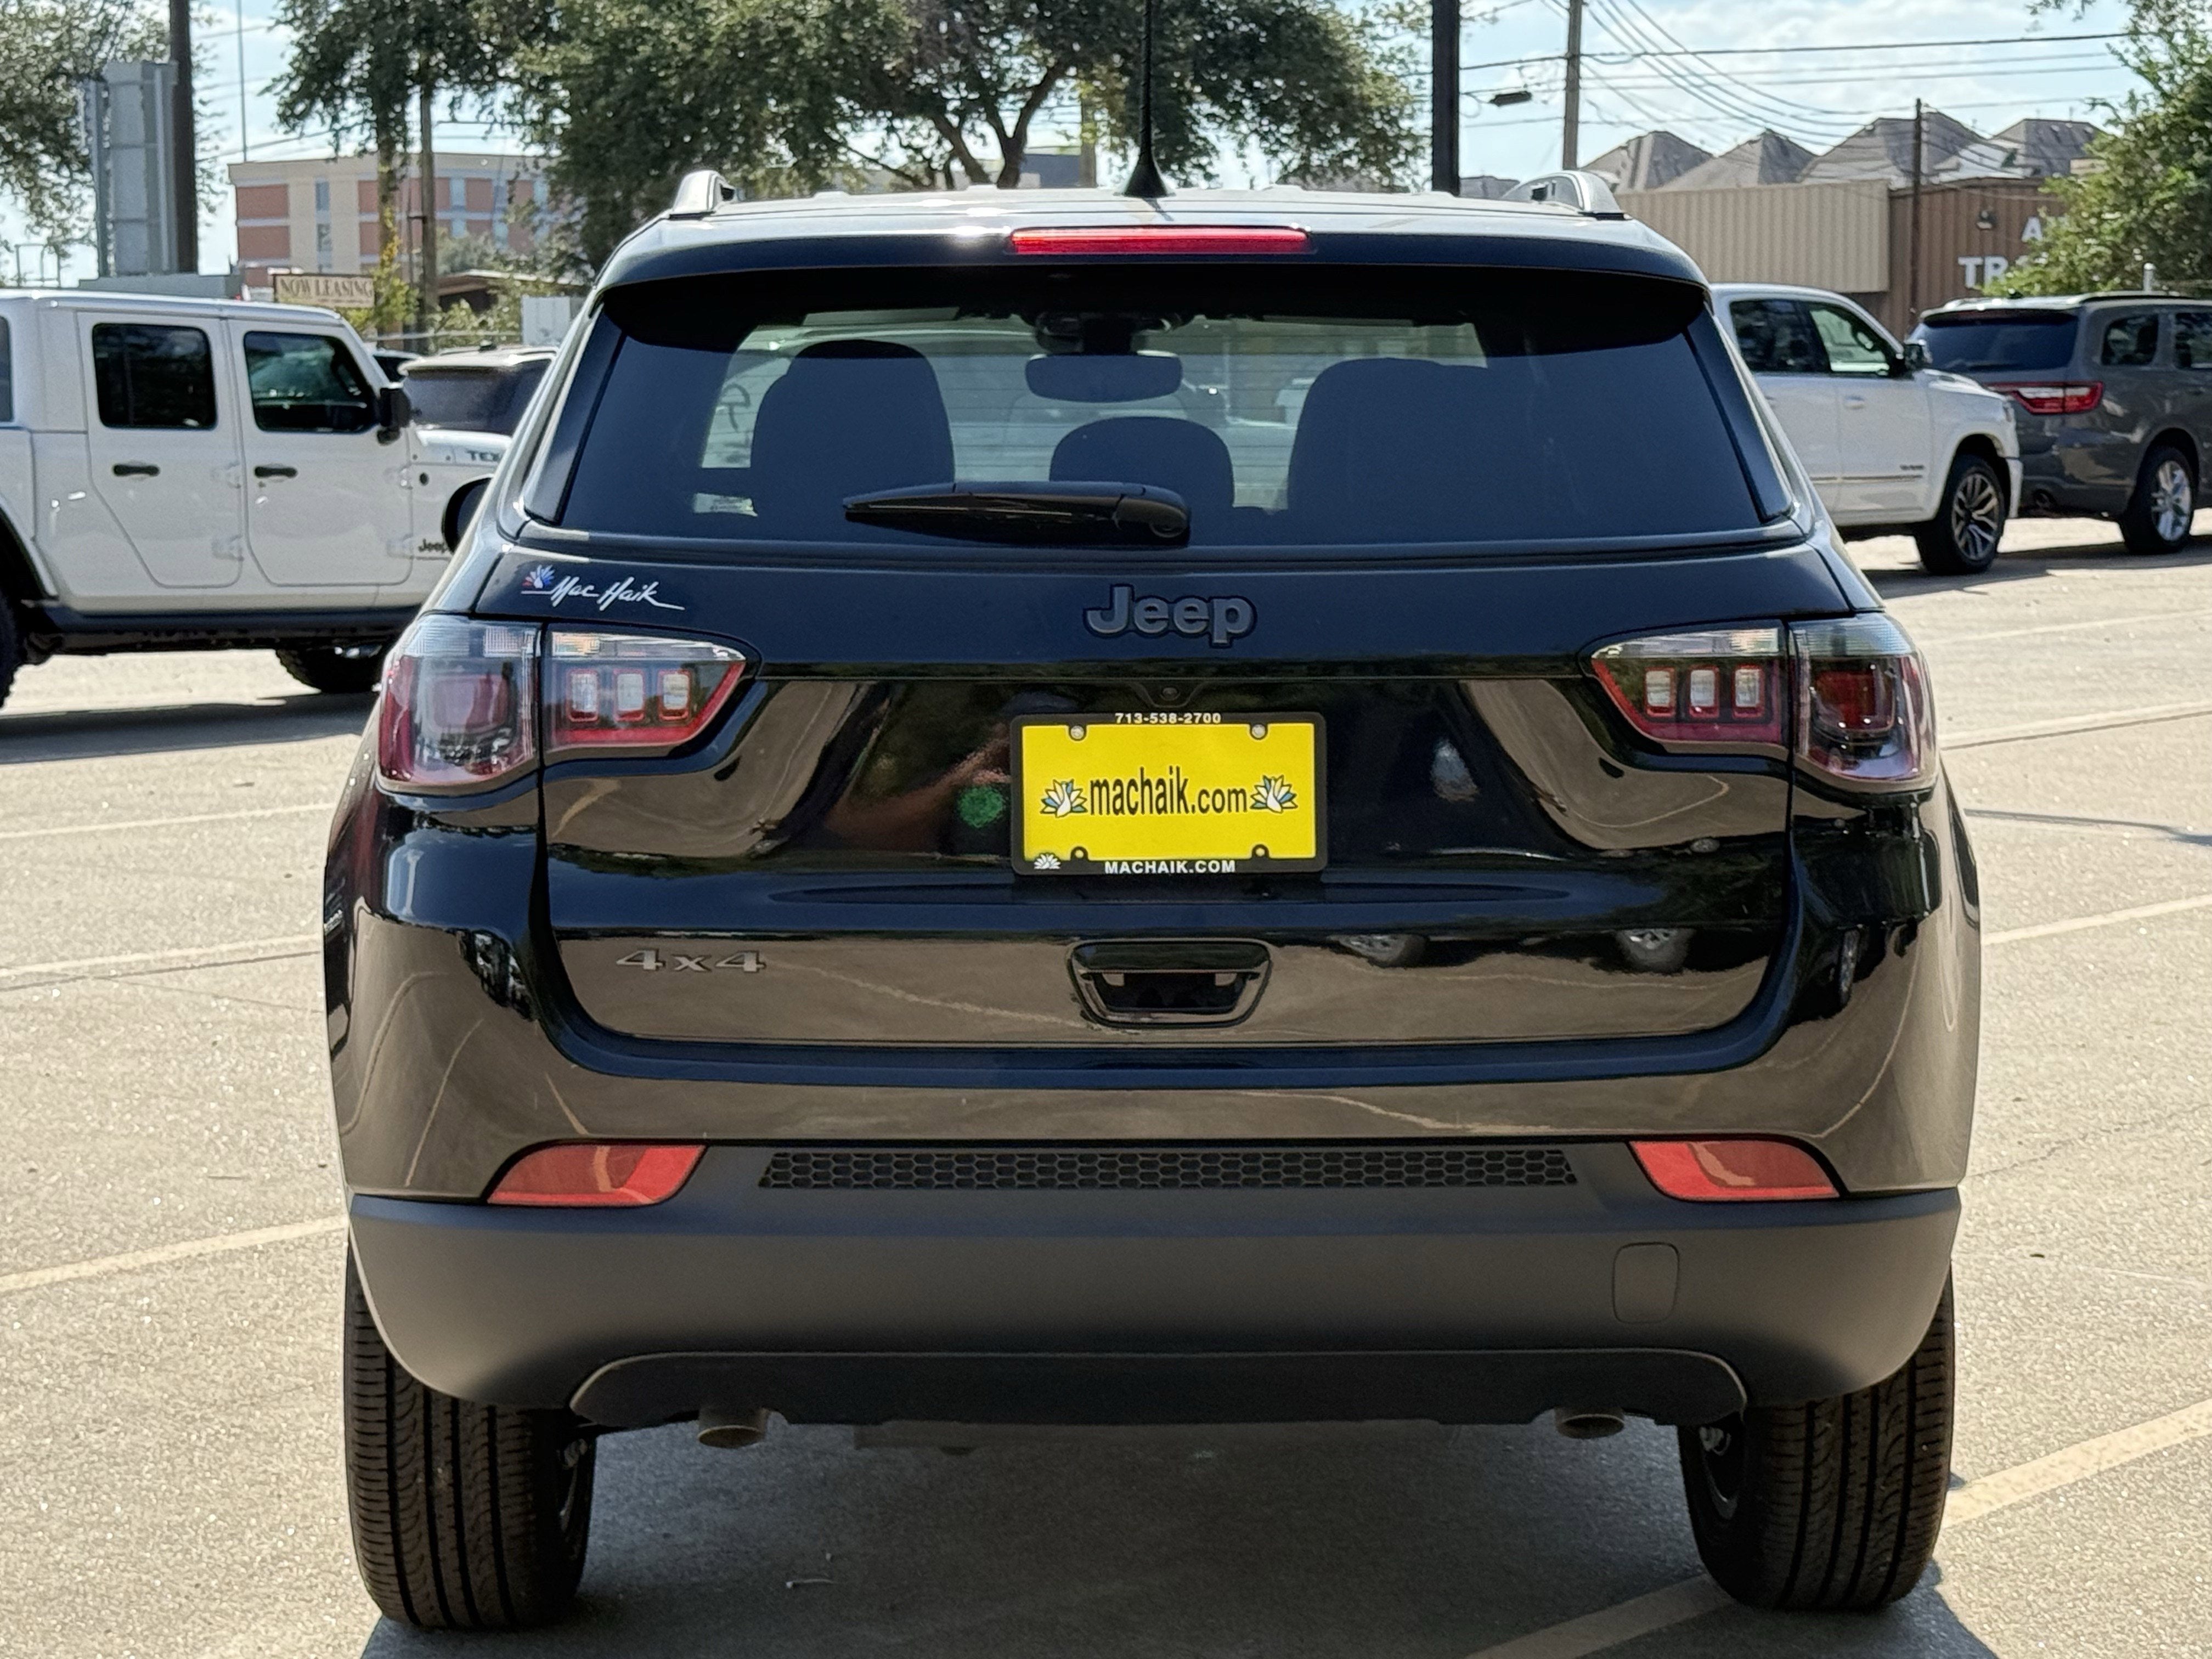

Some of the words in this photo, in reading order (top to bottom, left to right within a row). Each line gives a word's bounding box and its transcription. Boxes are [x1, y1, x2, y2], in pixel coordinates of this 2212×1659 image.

[280, 279, 311, 297] NOW
[314, 279, 375, 297] LEASING
[522, 576, 600, 607] Mac
[596, 577, 685, 611] Haik
[1083, 584, 1257, 648] Jeep
[1115, 713, 1221, 724] 713-538-2700
[1090, 765, 1248, 815] machaik.com
[1104, 860, 1235, 874] MACHAIK.COM
[616, 949, 767, 973] 4x4
